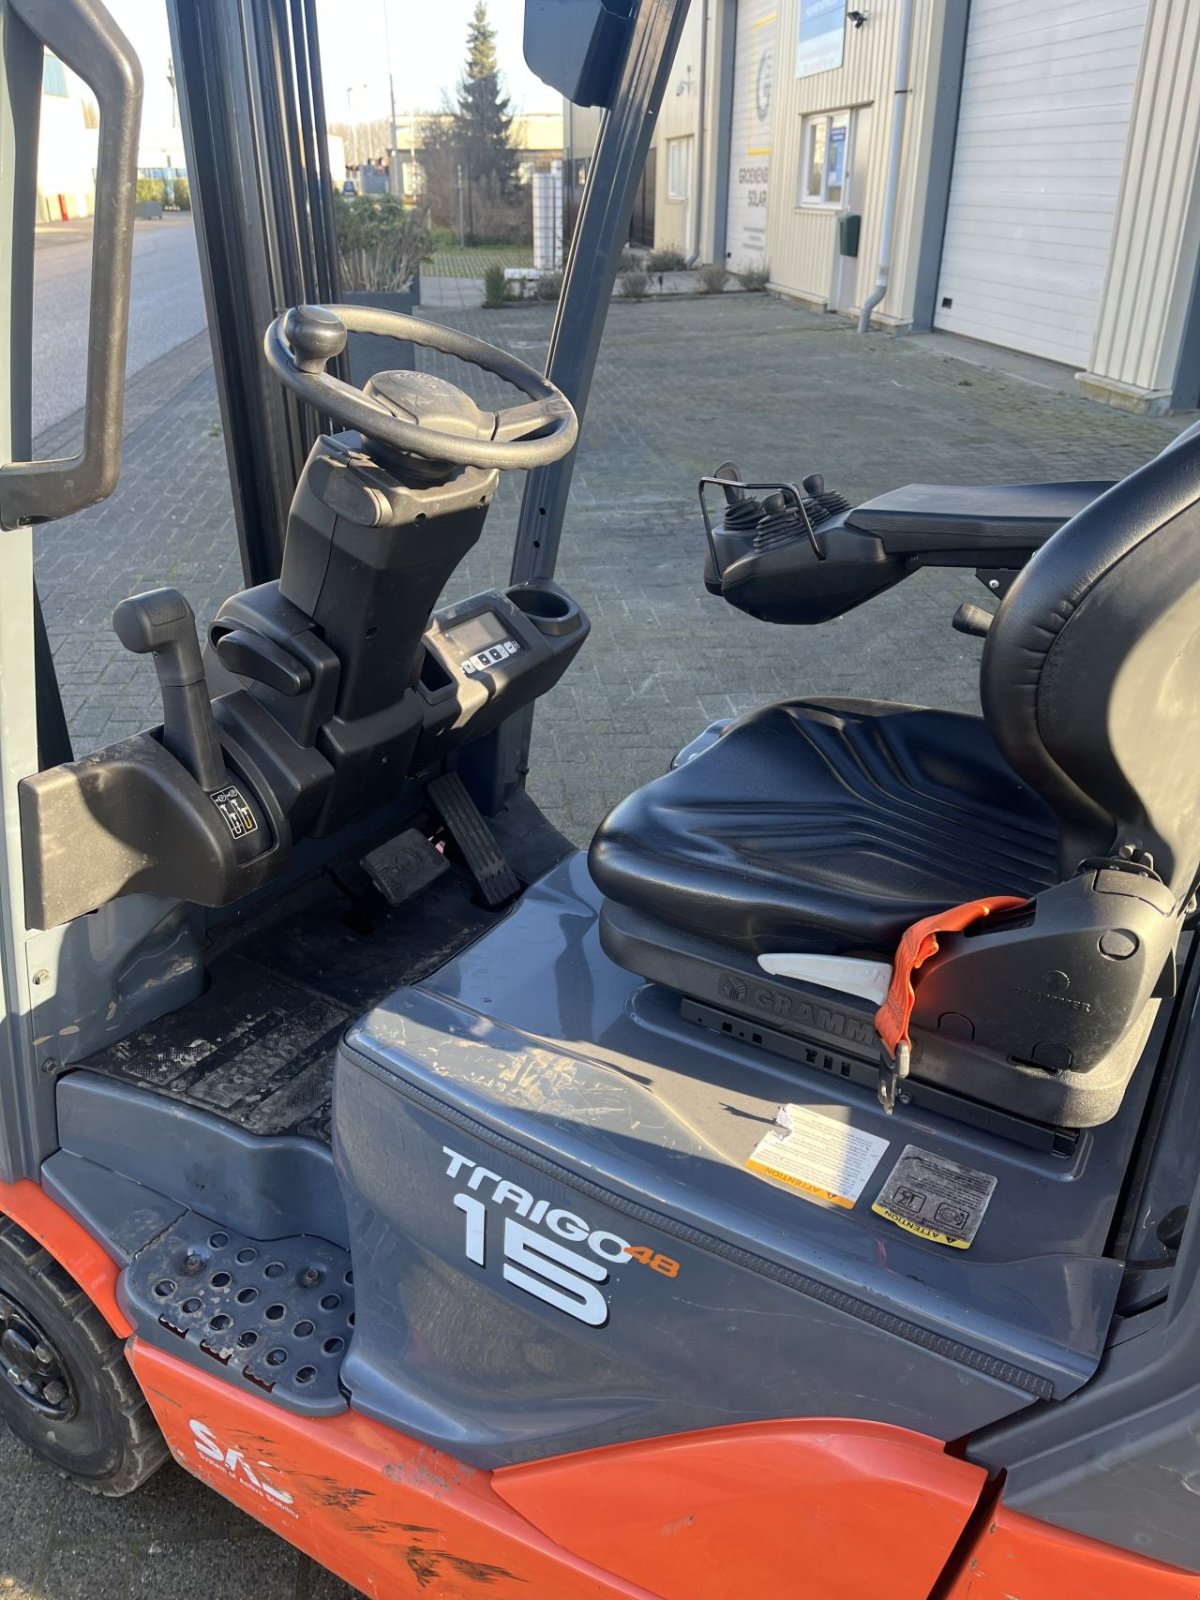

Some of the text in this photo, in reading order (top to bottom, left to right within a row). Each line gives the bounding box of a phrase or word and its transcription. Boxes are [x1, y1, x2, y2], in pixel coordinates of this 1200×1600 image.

[753, 989, 876, 1046] GRAMM
[764, 1167, 821, 1193] ATTENTION
[443, 1145, 680, 1279] TRAIGO 48
[884, 1210, 940, 1238] ATTENTION
[453, 1192, 609, 1327] 15
